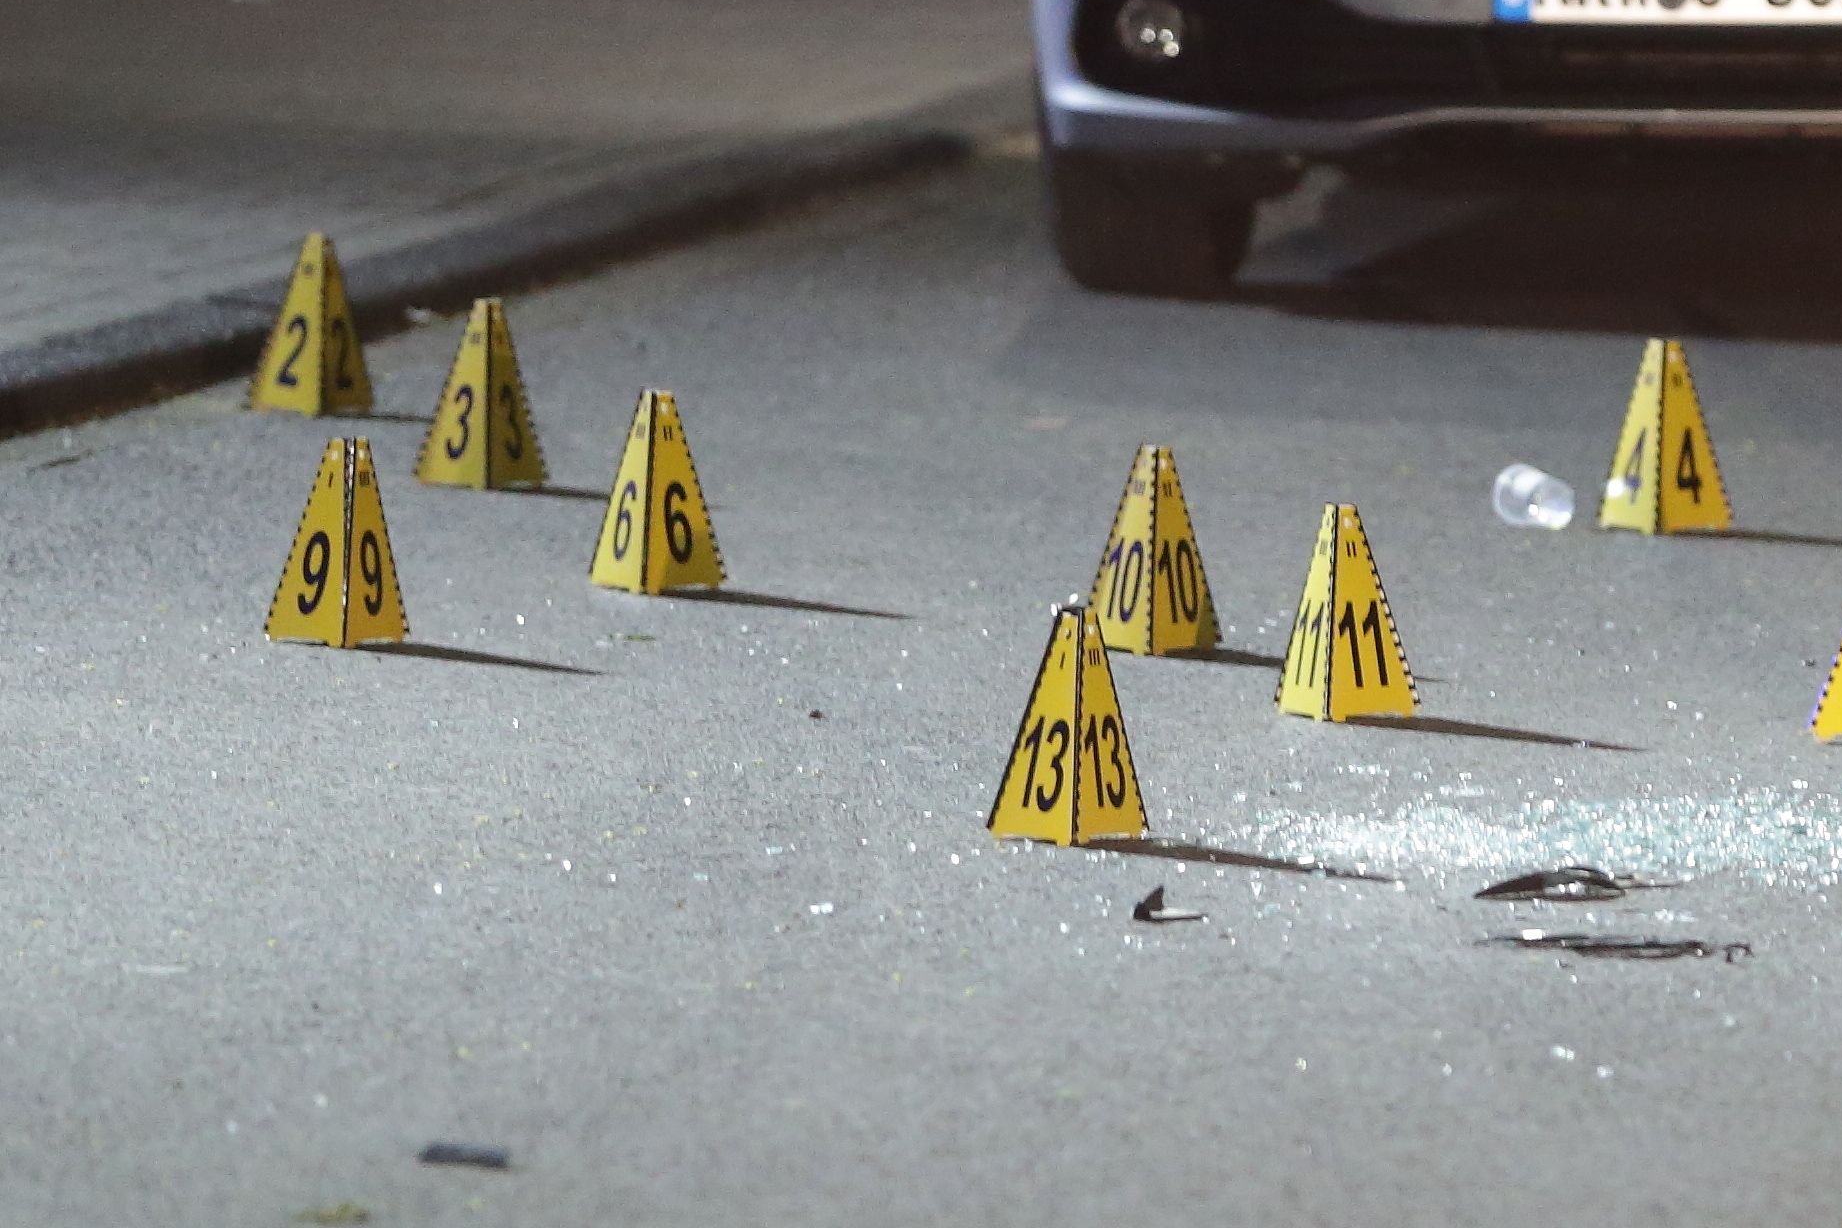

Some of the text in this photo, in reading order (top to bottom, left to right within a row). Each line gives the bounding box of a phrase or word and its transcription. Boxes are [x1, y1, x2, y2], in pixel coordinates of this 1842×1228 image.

[277, 315, 308, 386] 2
[331, 318, 355, 388] 2
[447, 384, 473, 459] 3
[501, 384, 523, 459] 3
[1625, 428, 1646, 504] 4
[1677, 428, 1702, 504] 4
[613, 481, 637, 561] 6
[663, 481, 693, 563] 6
[298, 531, 330, 615] 9
[359, 530, 383, 616] 9
[1106, 538, 1145, 622] 10
[1157, 540, 1199, 624] 10
[1295, 598, 1324, 688] 11
[1338, 599, 1390, 688] 11
[1022, 715, 1070, 813] 13
[1084, 714, 1126, 809] 13
